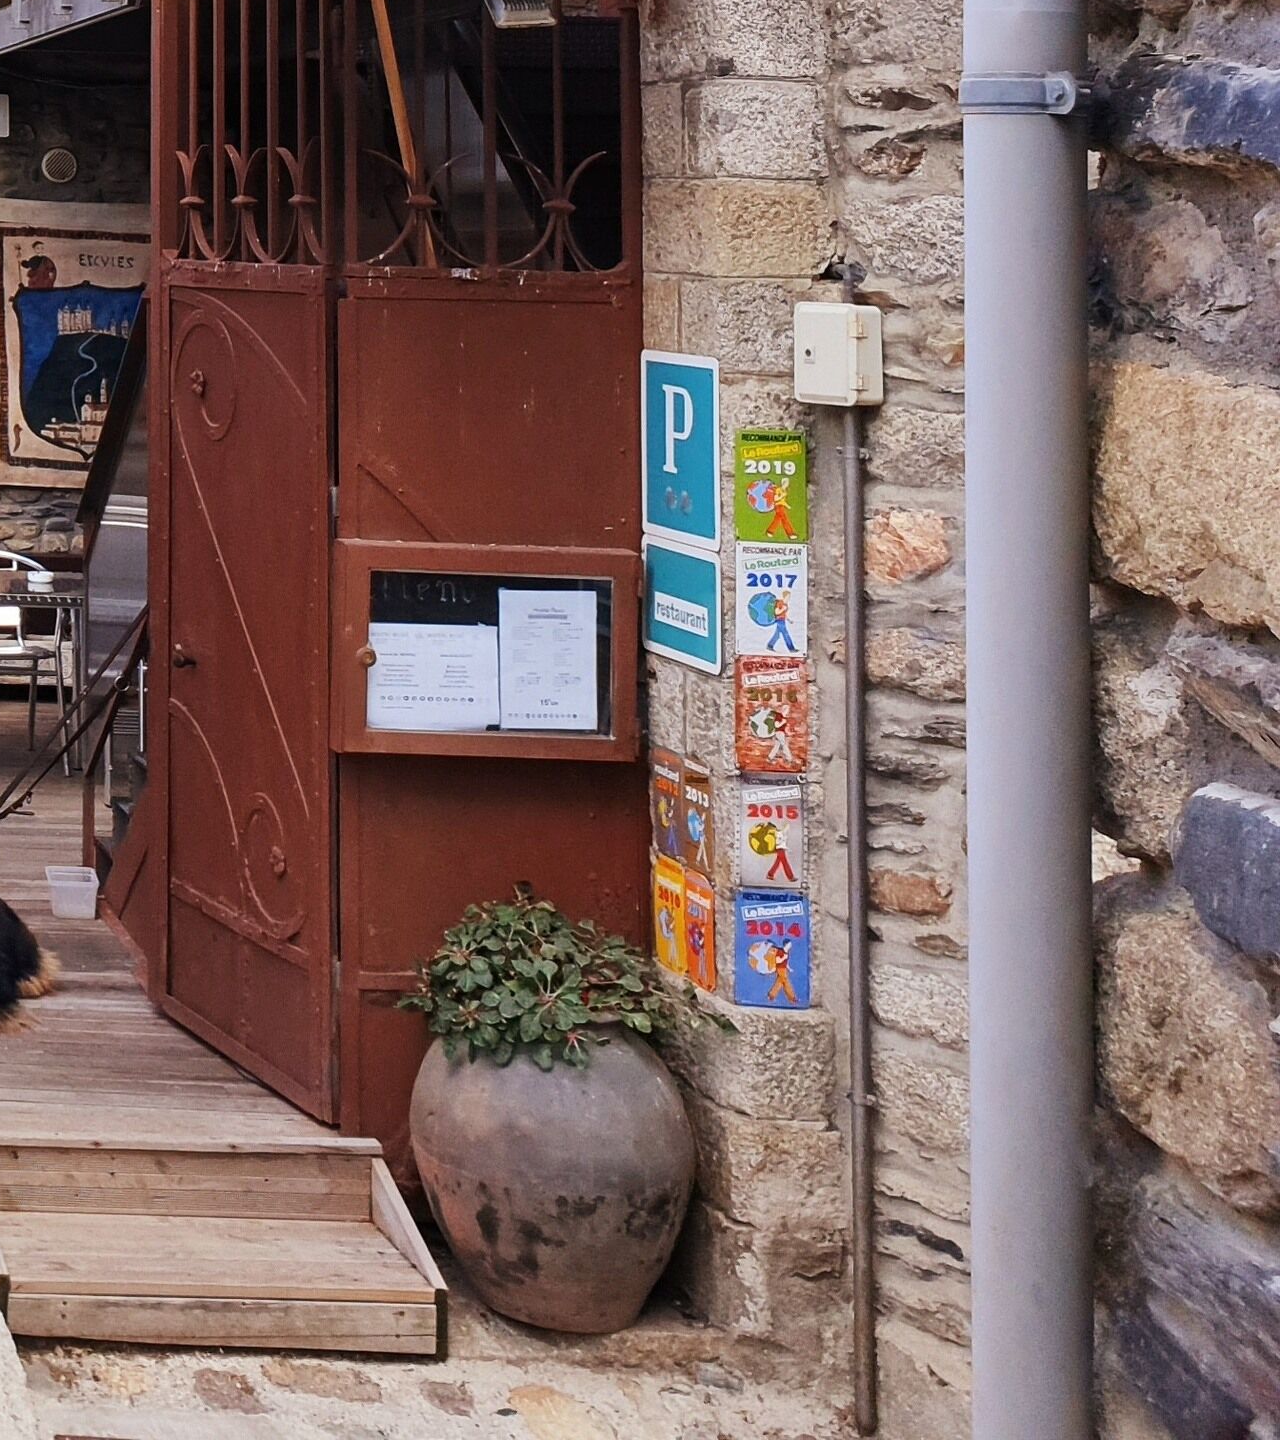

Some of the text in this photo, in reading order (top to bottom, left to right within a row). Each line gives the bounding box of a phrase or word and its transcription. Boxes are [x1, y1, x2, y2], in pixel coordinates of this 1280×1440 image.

[662, 383, 694, 475] P
[745, 460, 796, 475] 2019
[745, 557, 798, 570] Le Routard
[746, 572, 797, 588] 2017
[657, 601, 707, 632] restaurant
[684, 784, 710, 808] 2013
[747, 803, 799, 820] 2015
[745, 904, 801, 918] Le Routard
[746, 920, 802, 937] 2014
